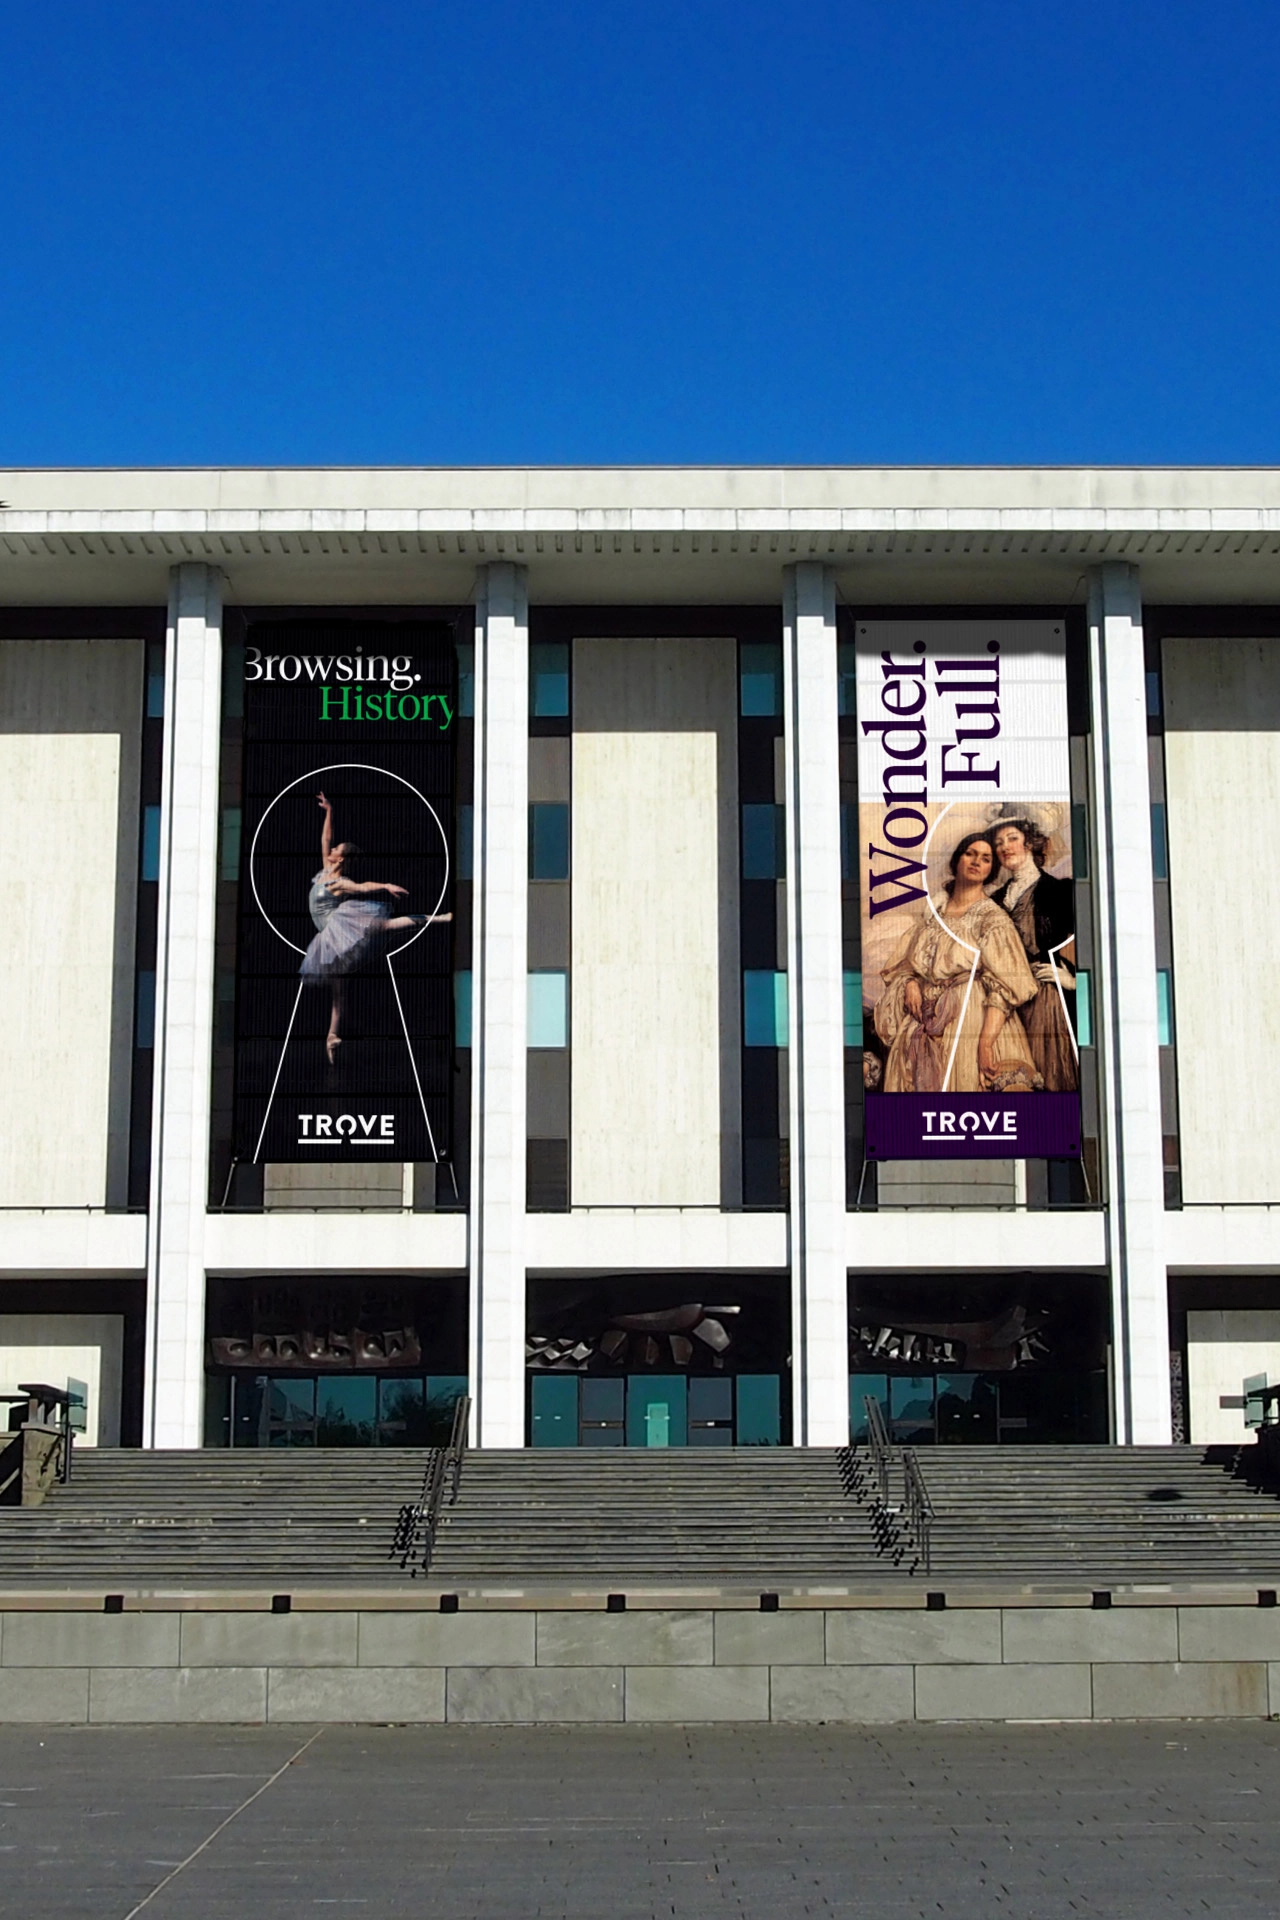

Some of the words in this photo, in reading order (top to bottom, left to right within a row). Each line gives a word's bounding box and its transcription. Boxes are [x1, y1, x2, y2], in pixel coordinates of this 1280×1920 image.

[245, 646, 421, 691] Browsing.
[319, 685, 454, 730] History
[934, 640, 1001, 788] Full.
[861, 640, 928, 919] Wonder.
[298, 1114, 395, 1136] TROVE
[922, 1111, 1018, 1133] TROVE
